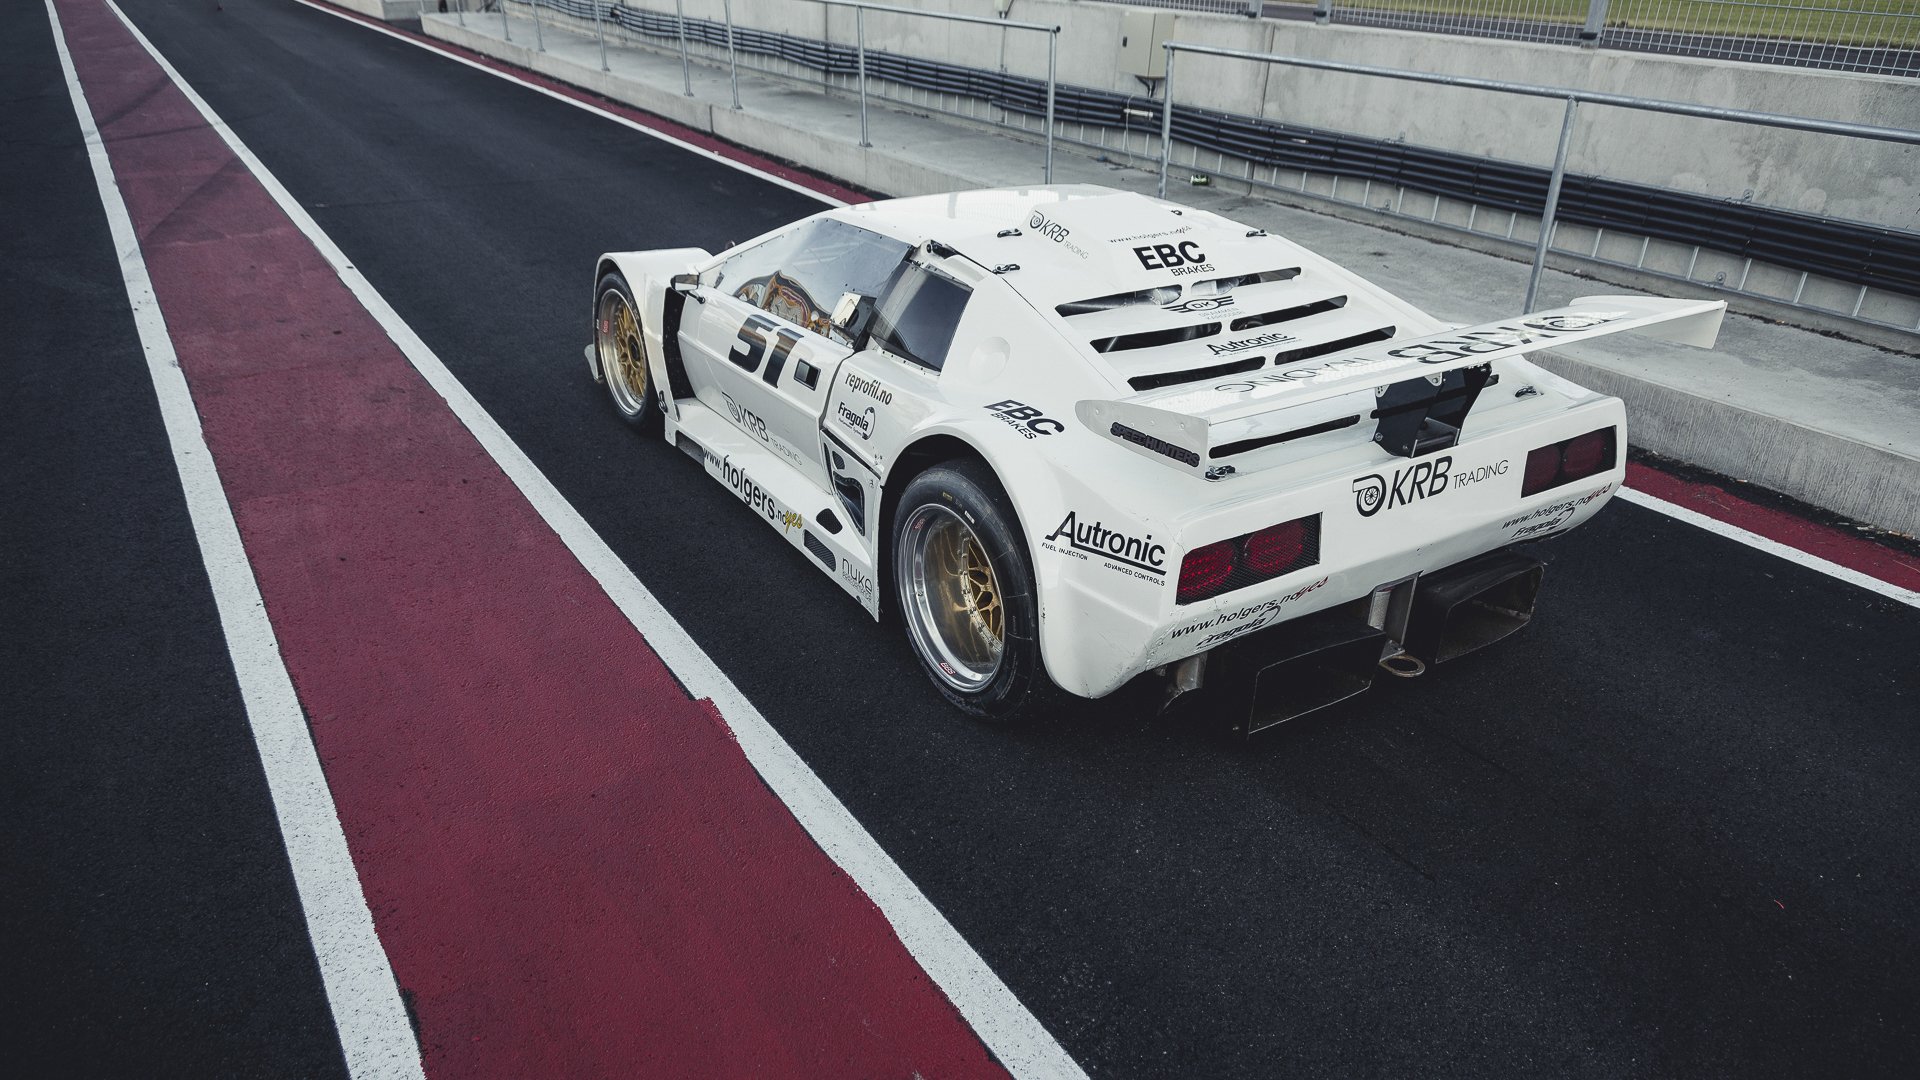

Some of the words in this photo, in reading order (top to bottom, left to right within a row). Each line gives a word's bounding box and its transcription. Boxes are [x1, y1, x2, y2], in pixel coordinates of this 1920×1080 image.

[1039, 219, 1070, 243] KRB
[1063, 240, 1089, 260] TRADING
[1133, 240, 1206, 270] EBC
[1170, 264, 1216, 277] BRAKES
[1191, 301, 1211, 310] DK
[1206, 332, 1289, 355] Autronic
[844, 371, 893, 405] reprofil.no
[739, 403, 769, 443] KRB
[838, 401, 870, 432] Fragola
[984, 399, 1065, 436] EBC
[990, 413, 1037, 440] BRAKES
[1387, 455, 1453, 511] KRB
[1453, 459, 1509, 490] TRADING
[1041, 541, 1057, 552] FUEL
[1058, 546, 1088, 561] INJECTION
[1045, 510, 1166, 570] Autronic
[842, 557, 873, 595] nuke
[1103, 561, 1133, 576] ADVANCED
[1133, 569, 1165, 587] CONTROLS
